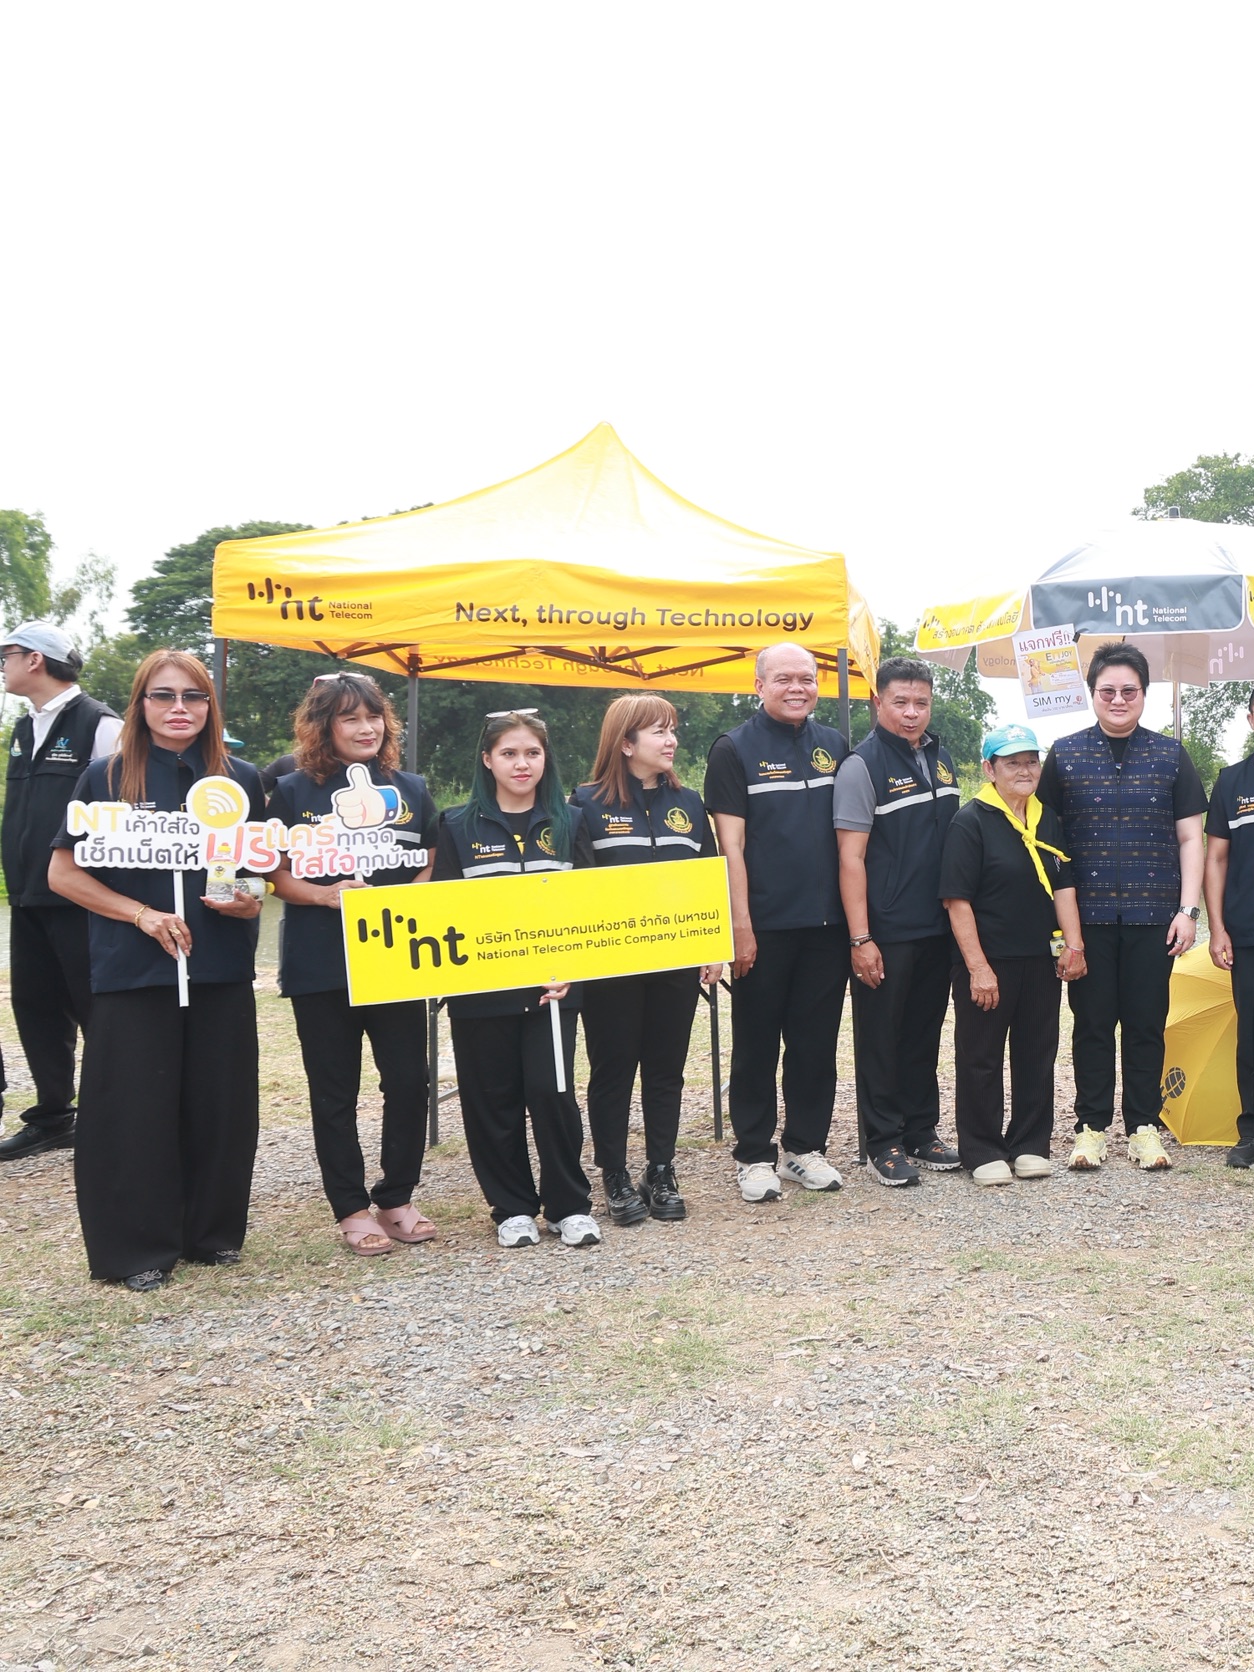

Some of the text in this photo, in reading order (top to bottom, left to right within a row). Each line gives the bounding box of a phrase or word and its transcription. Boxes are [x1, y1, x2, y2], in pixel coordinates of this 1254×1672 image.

[329, 601, 372, 609] National
[329, 611, 372, 619] Telecom
[455, 601, 814, 631] Next, through Technology
[1019, 630, 1070, 651] แจกฟรี!!
[1032, 696, 1052, 707] SIM
[1054, 695, 1071, 706] my
[73, 805, 200, 835] NT เค้าใส่ใจ
[476, 909, 720, 946] บริษัท โทรคมนาคมแห่งชาติ จำกัด (มหาชน)
[477, 924, 721, 961] National Telecom Public Company Limited
